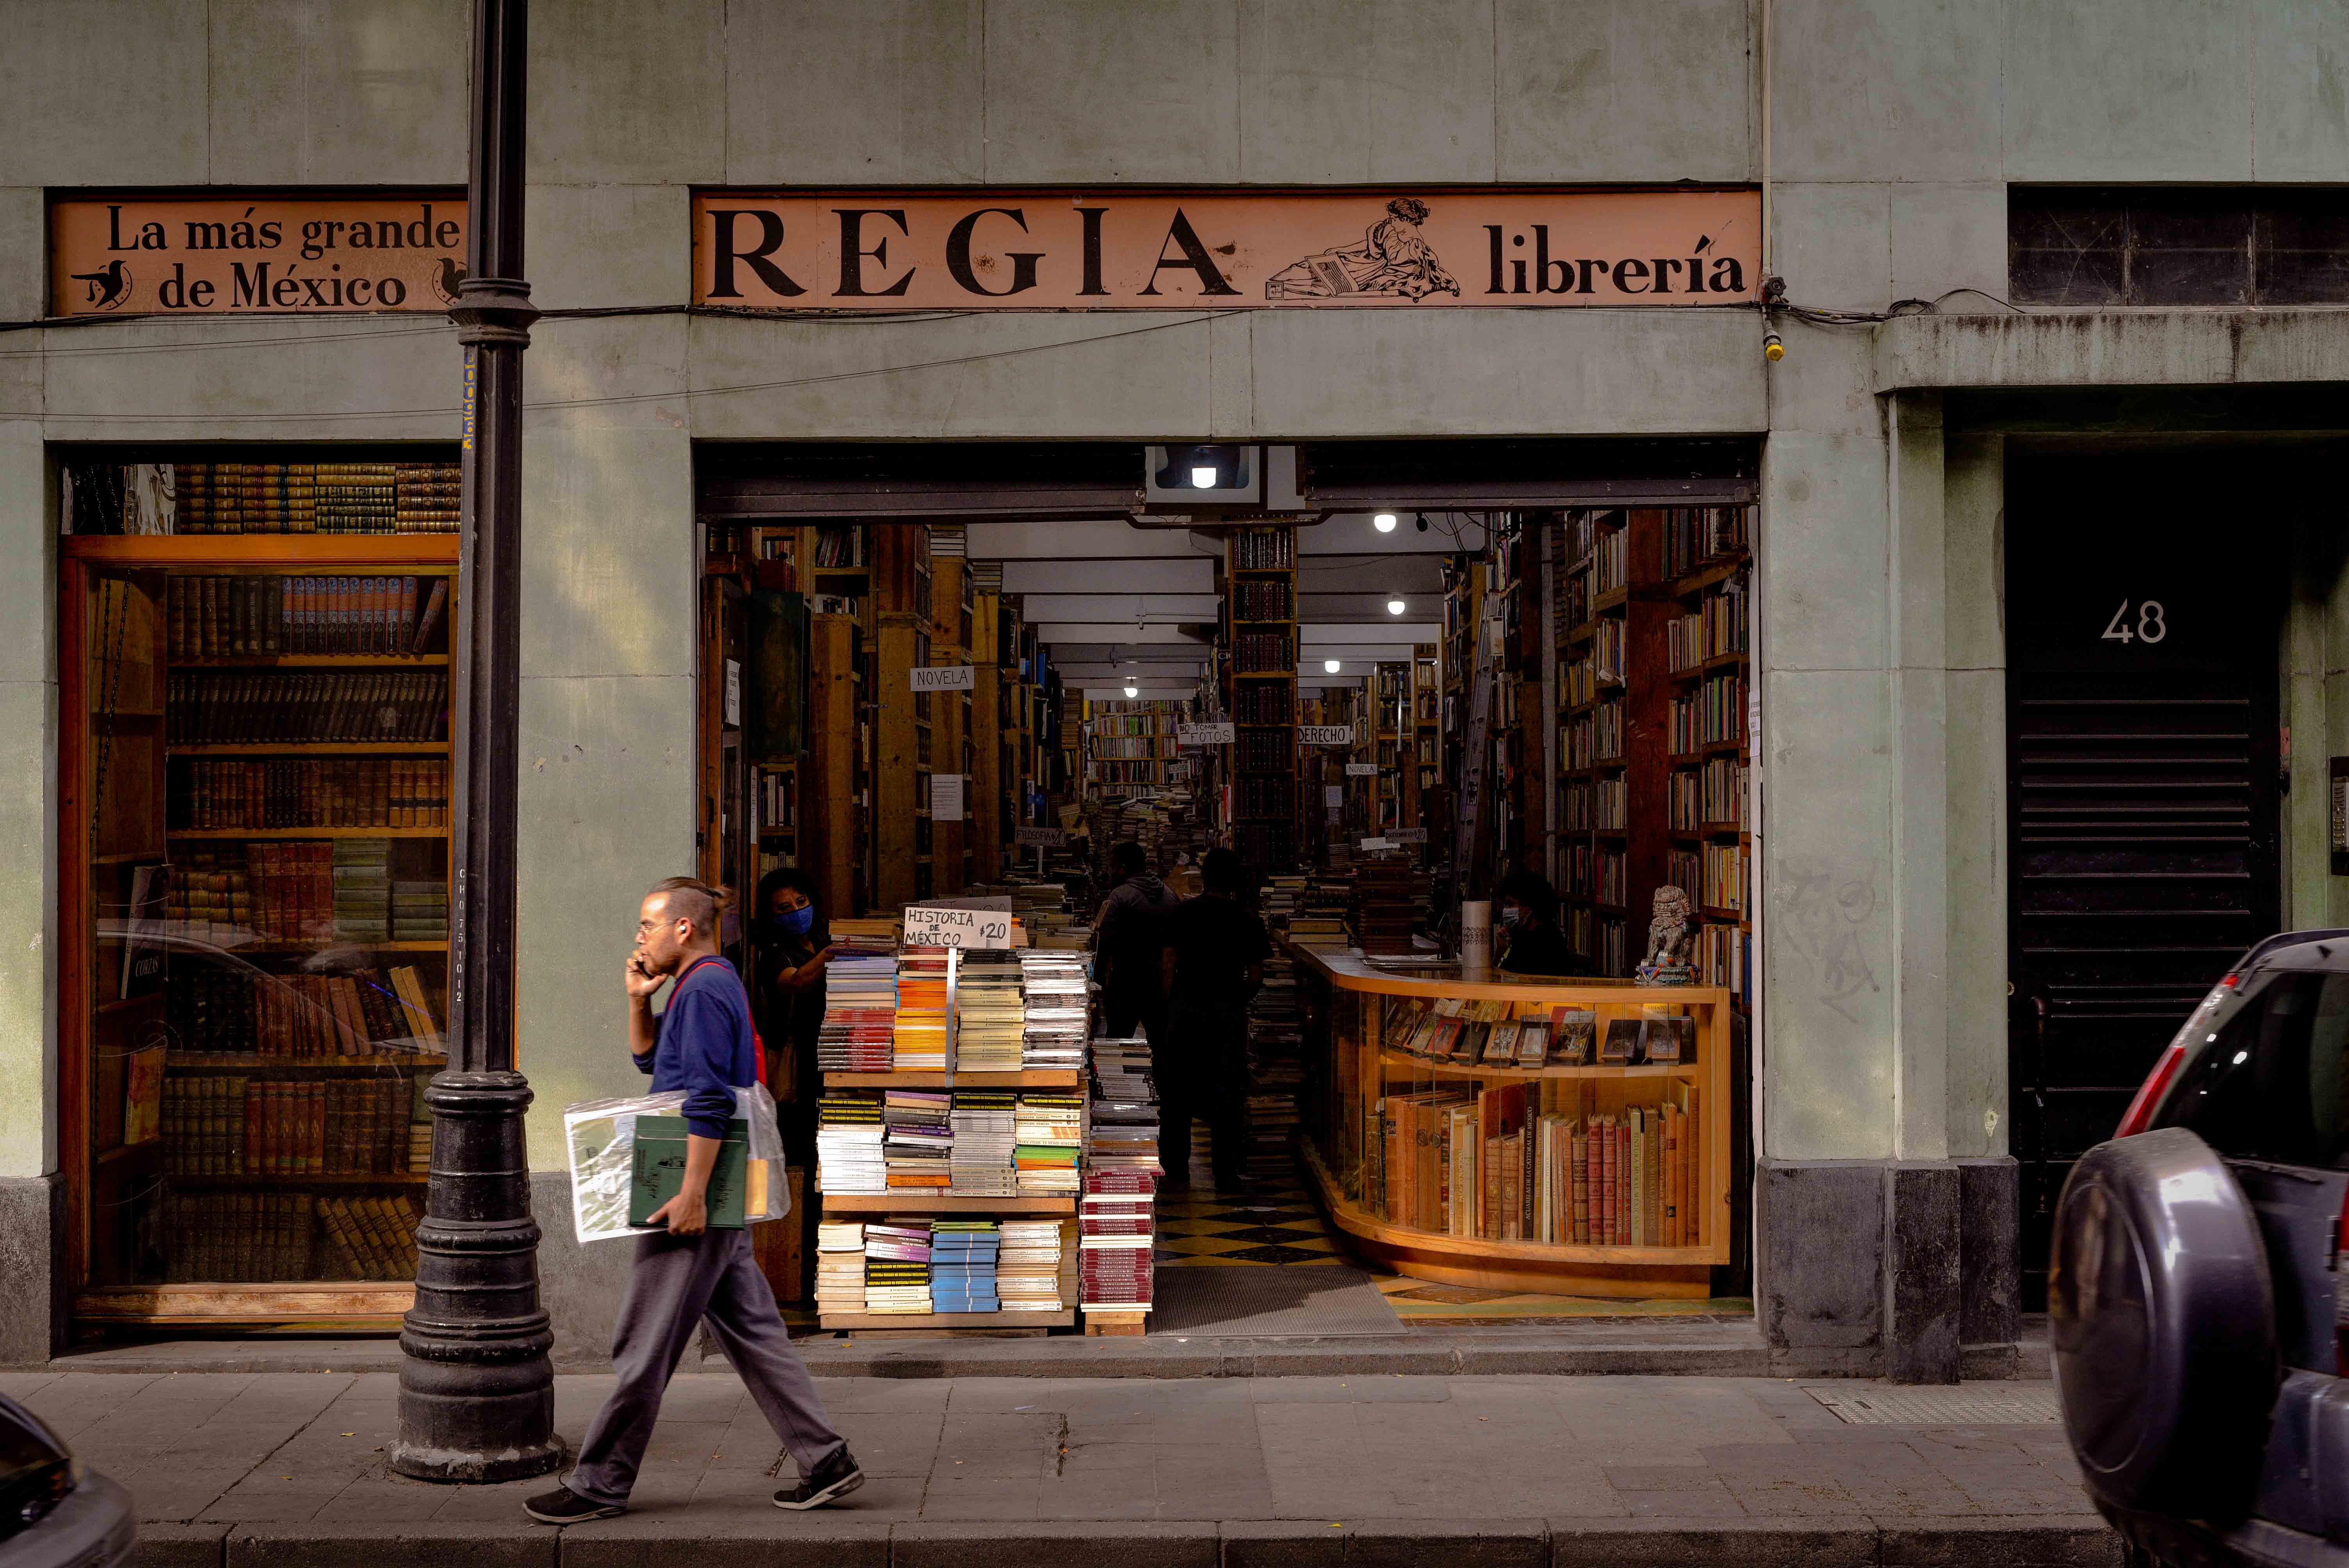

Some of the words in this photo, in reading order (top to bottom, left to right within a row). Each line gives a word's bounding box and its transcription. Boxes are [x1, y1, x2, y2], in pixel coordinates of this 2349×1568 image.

[107, 205, 167, 251] La
[185, 207, 282, 249] más
[301, 204, 460, 260] grande
[706, 207, 1243, 297] REGIA
[1483, 224, 1749, 296] librería
[159, 263, 214, 308] de
[231, 262, 406, 307] México
[2101, 598, 2166, 643] 48
[918, 669, 968, 685] NOVELA
[1191, 731, 1231, 743] FOTOS
[1297, 728, 1345, 742] DERECHO
[1349, 765, 1375, 773] NOVELA
[909, 909, 974, 927] HISTORIA
[905, 930, 961, 946] MÉXICO
[979, 923, 1006, 939] $20
[1527, 1130, 1532, 1139] DE
[1526, 1178, 1531, 1186] DE
